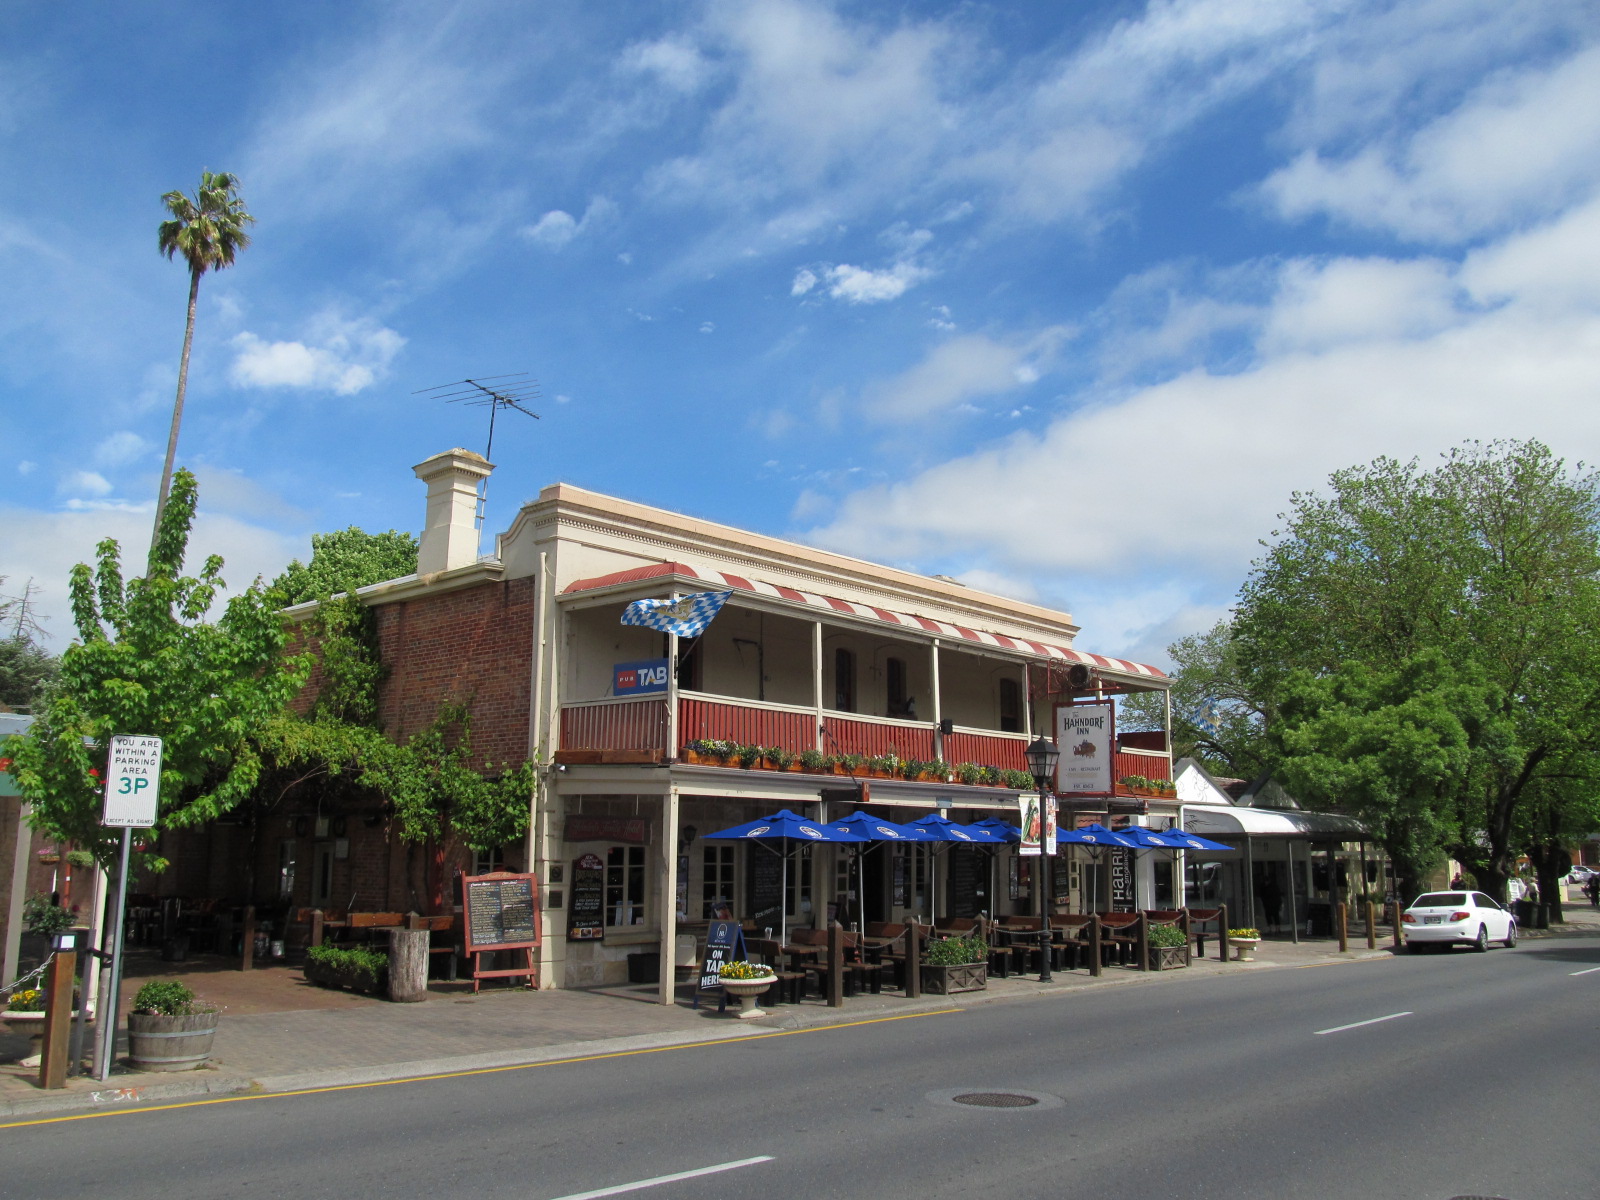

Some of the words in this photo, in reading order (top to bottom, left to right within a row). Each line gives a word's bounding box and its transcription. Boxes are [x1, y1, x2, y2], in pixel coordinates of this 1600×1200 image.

[638, 666, 667, 686] TAB
[1064, 716, 1104, 731] HAHNDORF
[1077, 727, 1090, 735] INN
[117, 738, 135, 746] YOU
[140, 740, 159, 748] ARE
[115, 748, 146, 757] WITHIN
[115, 757, 156, 766] PARKING
[117, 776, 149, 795] 3P
[712, 949, 723, 959] ON
